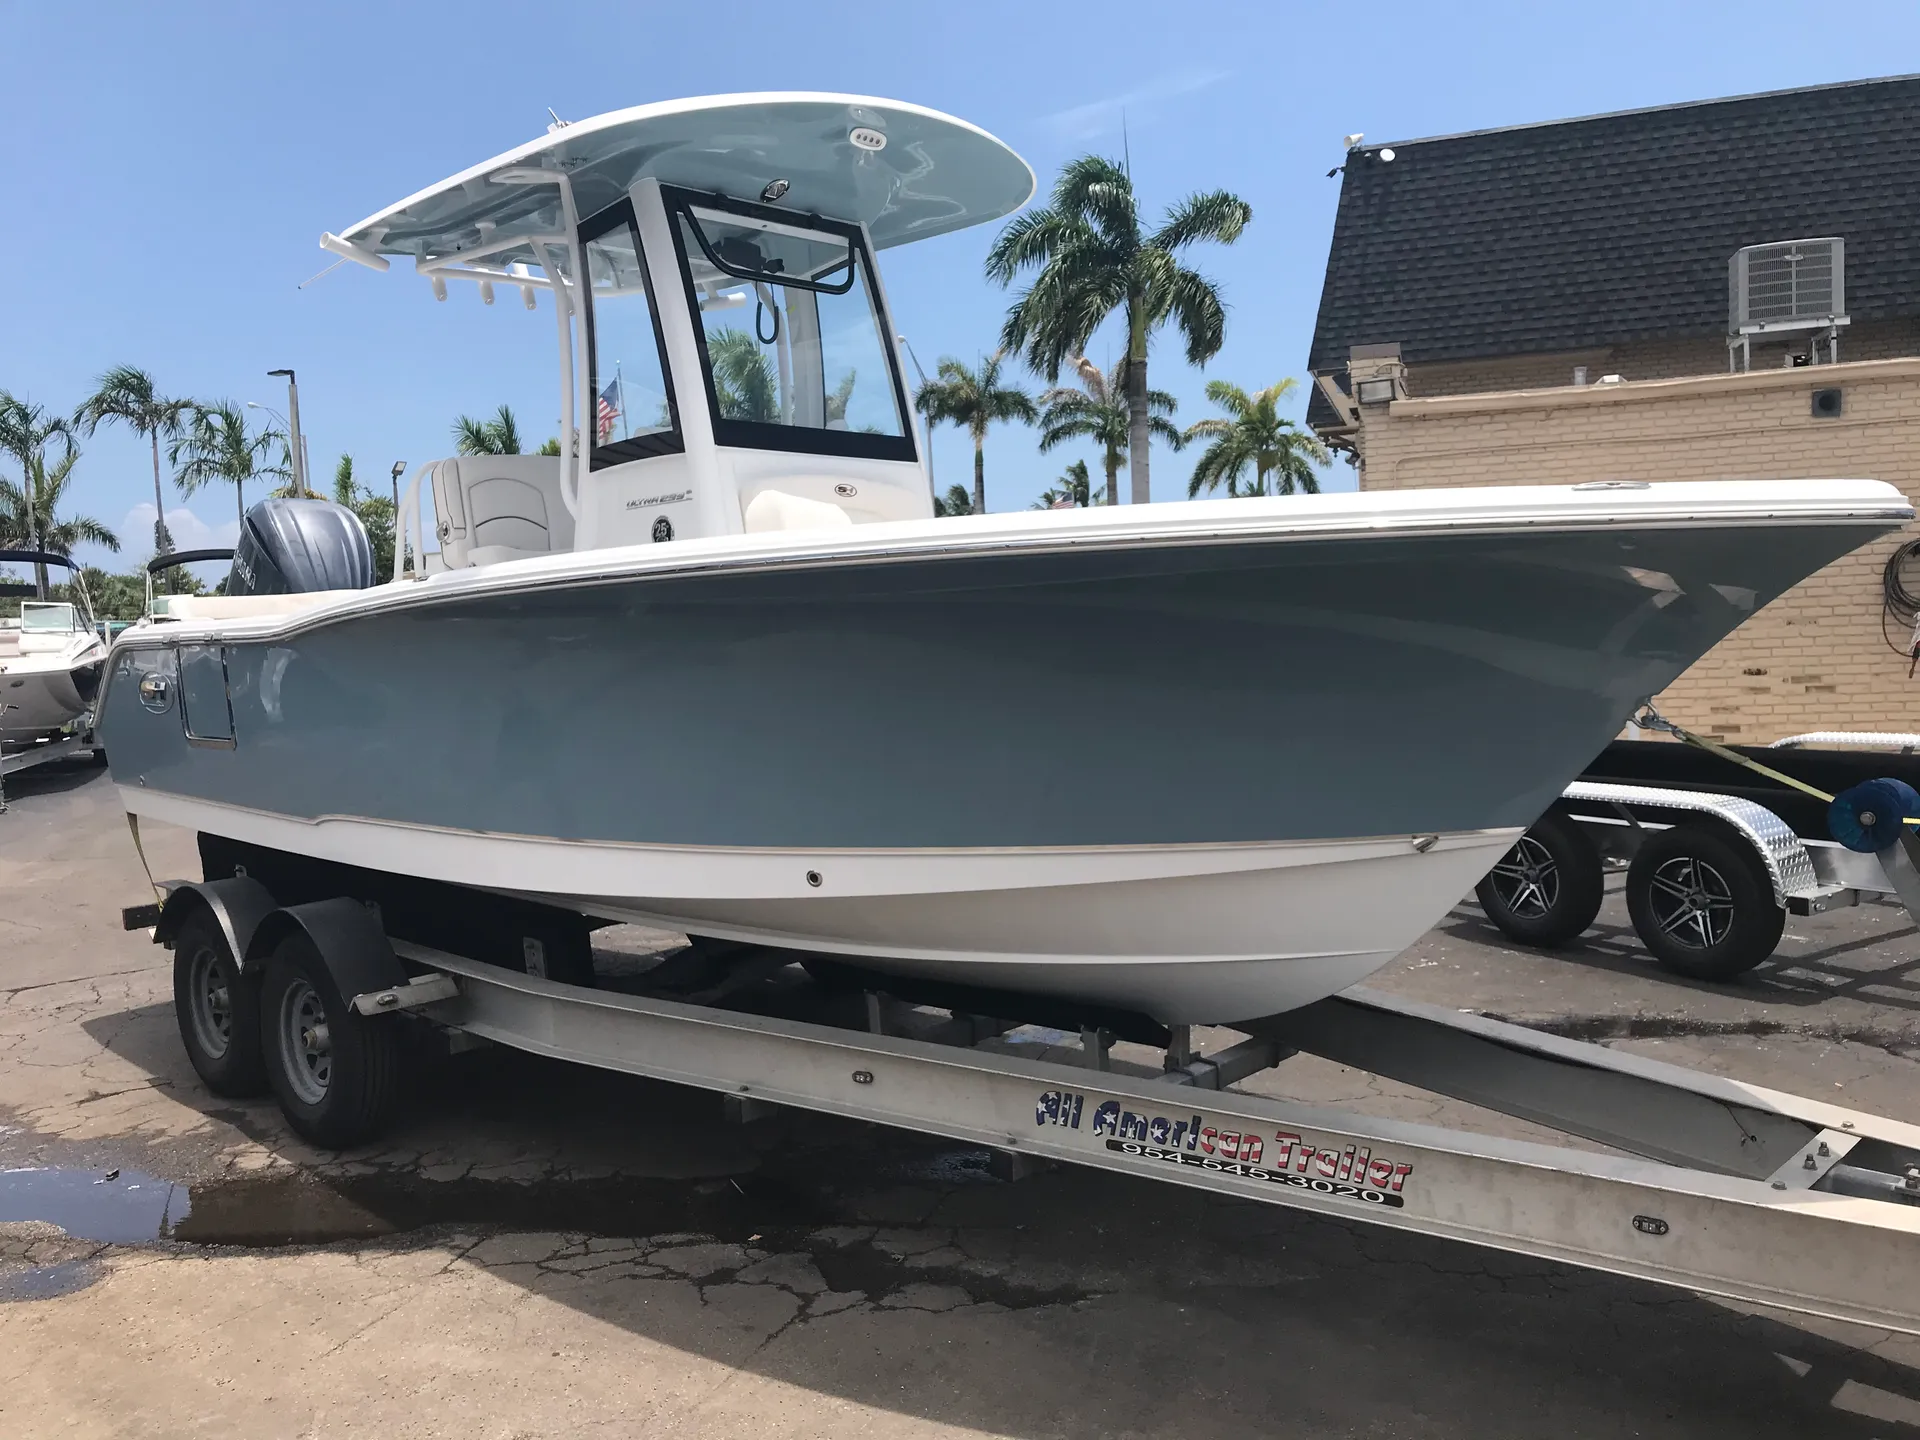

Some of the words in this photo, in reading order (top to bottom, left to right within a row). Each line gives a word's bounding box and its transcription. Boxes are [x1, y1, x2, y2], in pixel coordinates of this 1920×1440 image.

[1035, 1091, 1084, 1129] All
[1093, 1101, 1264, 1164] American
[1275, 1131, 1413, 1192] Trailer
[1122, 1142, 1385, 1204] 954-545-3020
